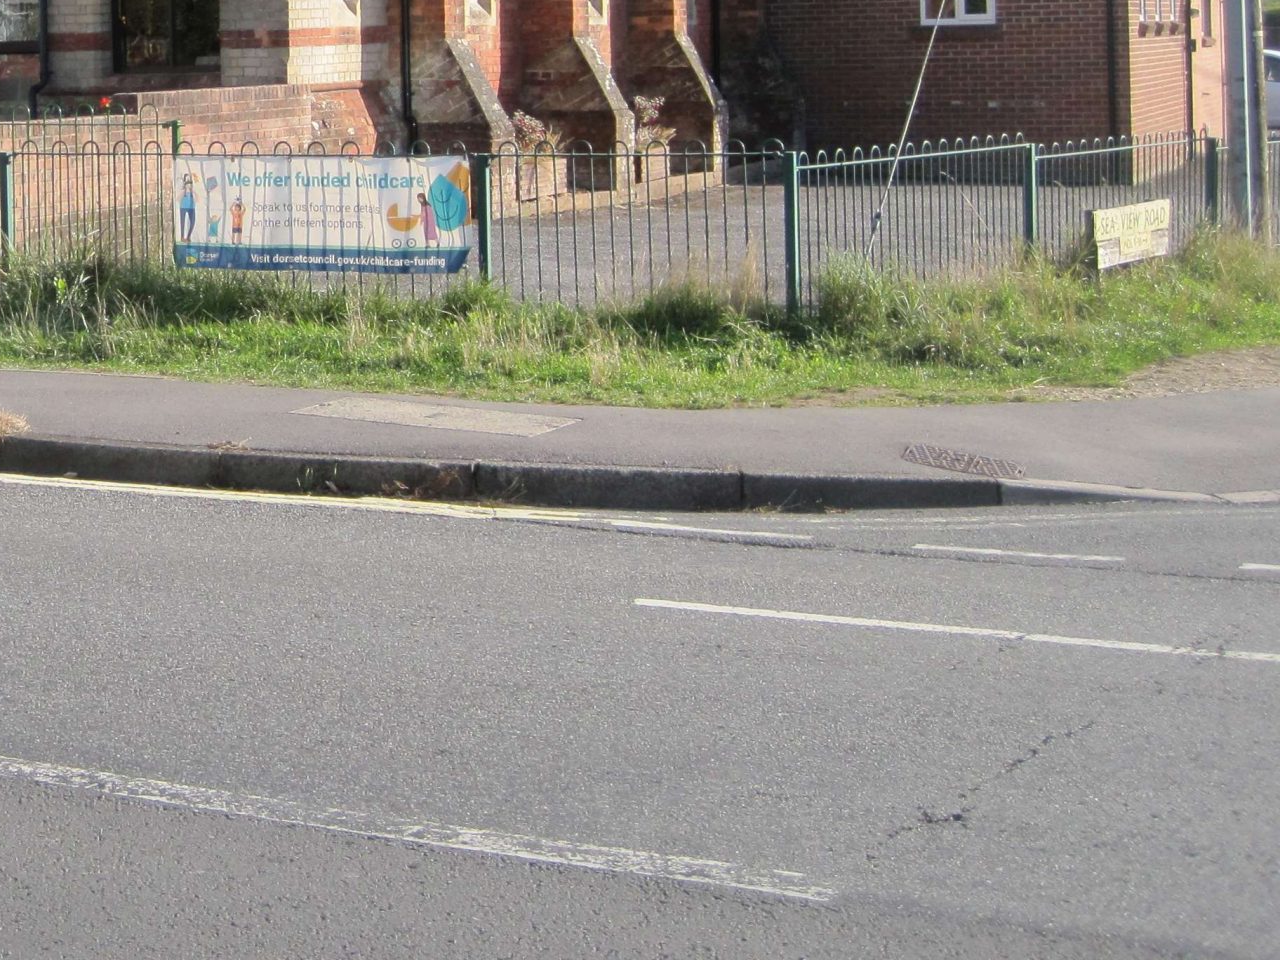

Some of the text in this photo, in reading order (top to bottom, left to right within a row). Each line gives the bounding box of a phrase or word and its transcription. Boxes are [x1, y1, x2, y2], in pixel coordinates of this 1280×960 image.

[227, 171, 424, 189] We offer funded childcare
[253, 202, 280, 214] Speak
[284, 203, 293, 212] to
[296, 204, 308, 212] us
[310, 202, 322, 212] for
[326, 203, 350, 213] more
[252, 220, 262, 228] on
[264, 218, 280, 228] the
[284, 218, 325, 228] different
[1121, 211, 1140, 230] VIEW
[1144, 206, 1166, 228] ROAD
[251, 253, 446, 268] Visit dorsetcouncil.gov.uk/childcare-funding
